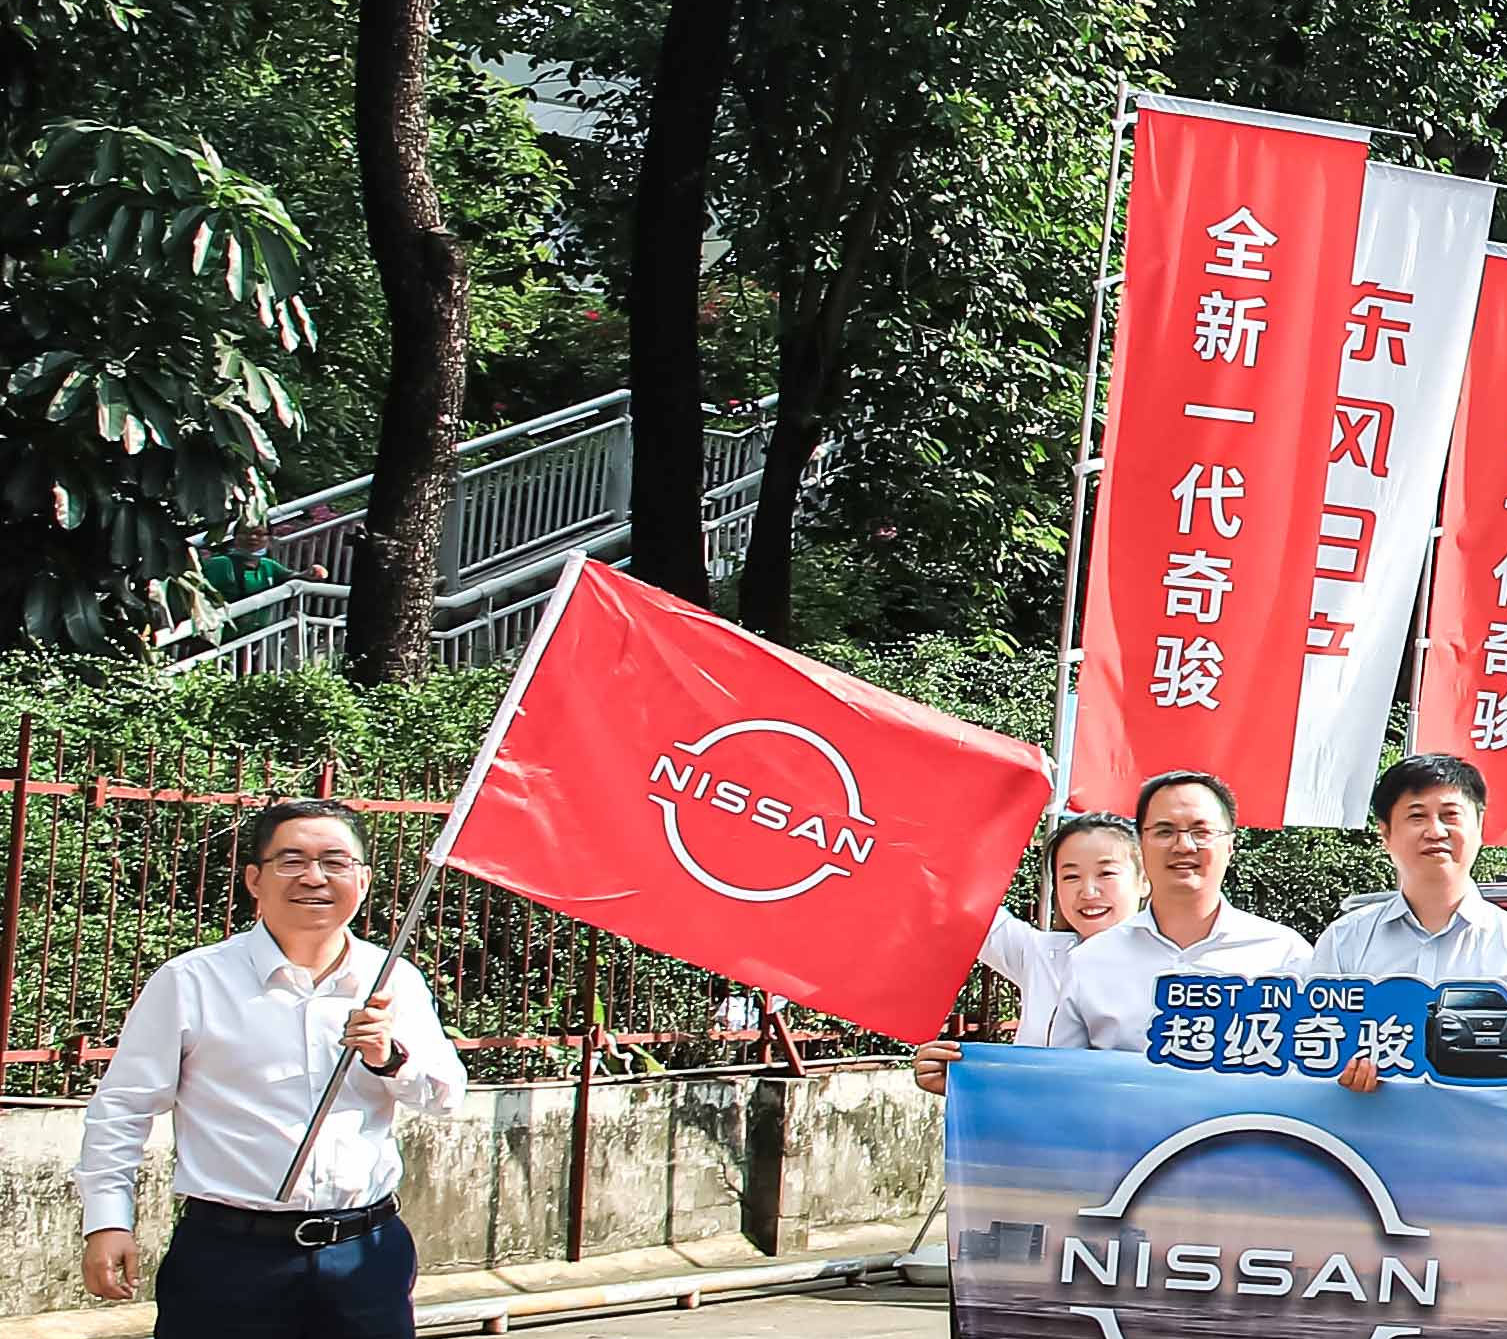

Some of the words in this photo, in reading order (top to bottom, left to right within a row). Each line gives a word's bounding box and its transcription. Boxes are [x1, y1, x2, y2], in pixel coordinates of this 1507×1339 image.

[1149, 206, 1278, 712] 全新一代奇骏
[649, 755, 876, 864] NISSAN
[1167, 983, 1247, 1010] BEST
[1261, 985, 1298, 1010] IN
[1310, 985, 1364, 1011] ONE
[1160, 1013, 1415, 1072] 超级奇骏
[1060, 1237, 1439, 1306] NISSAN
